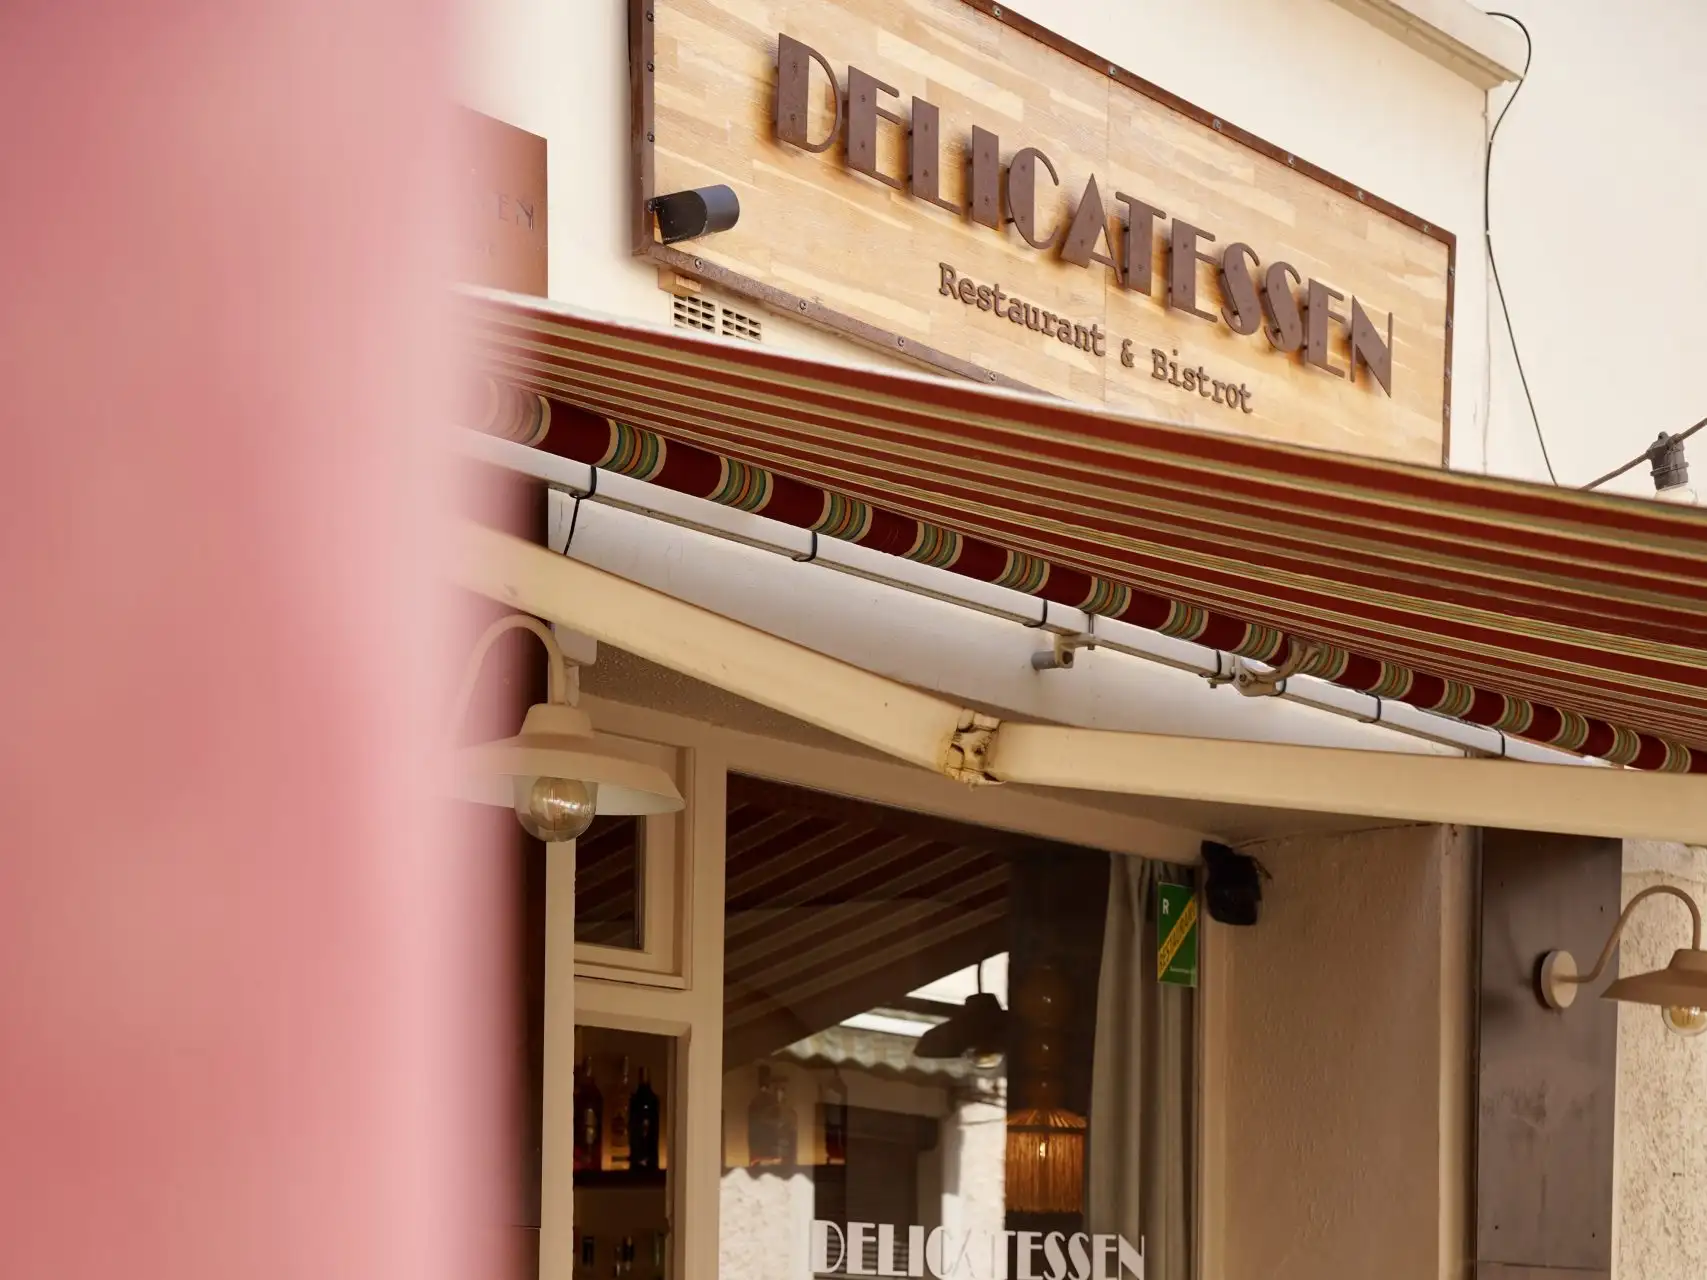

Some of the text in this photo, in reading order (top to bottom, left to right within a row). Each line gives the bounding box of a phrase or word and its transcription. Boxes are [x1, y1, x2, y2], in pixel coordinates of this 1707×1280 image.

[777, 33, 1393, 398] DELICATESSEN
[939, 263, 1253, 413] Restaurant & Bistrot
[1162, 898, 1170, 915] R
